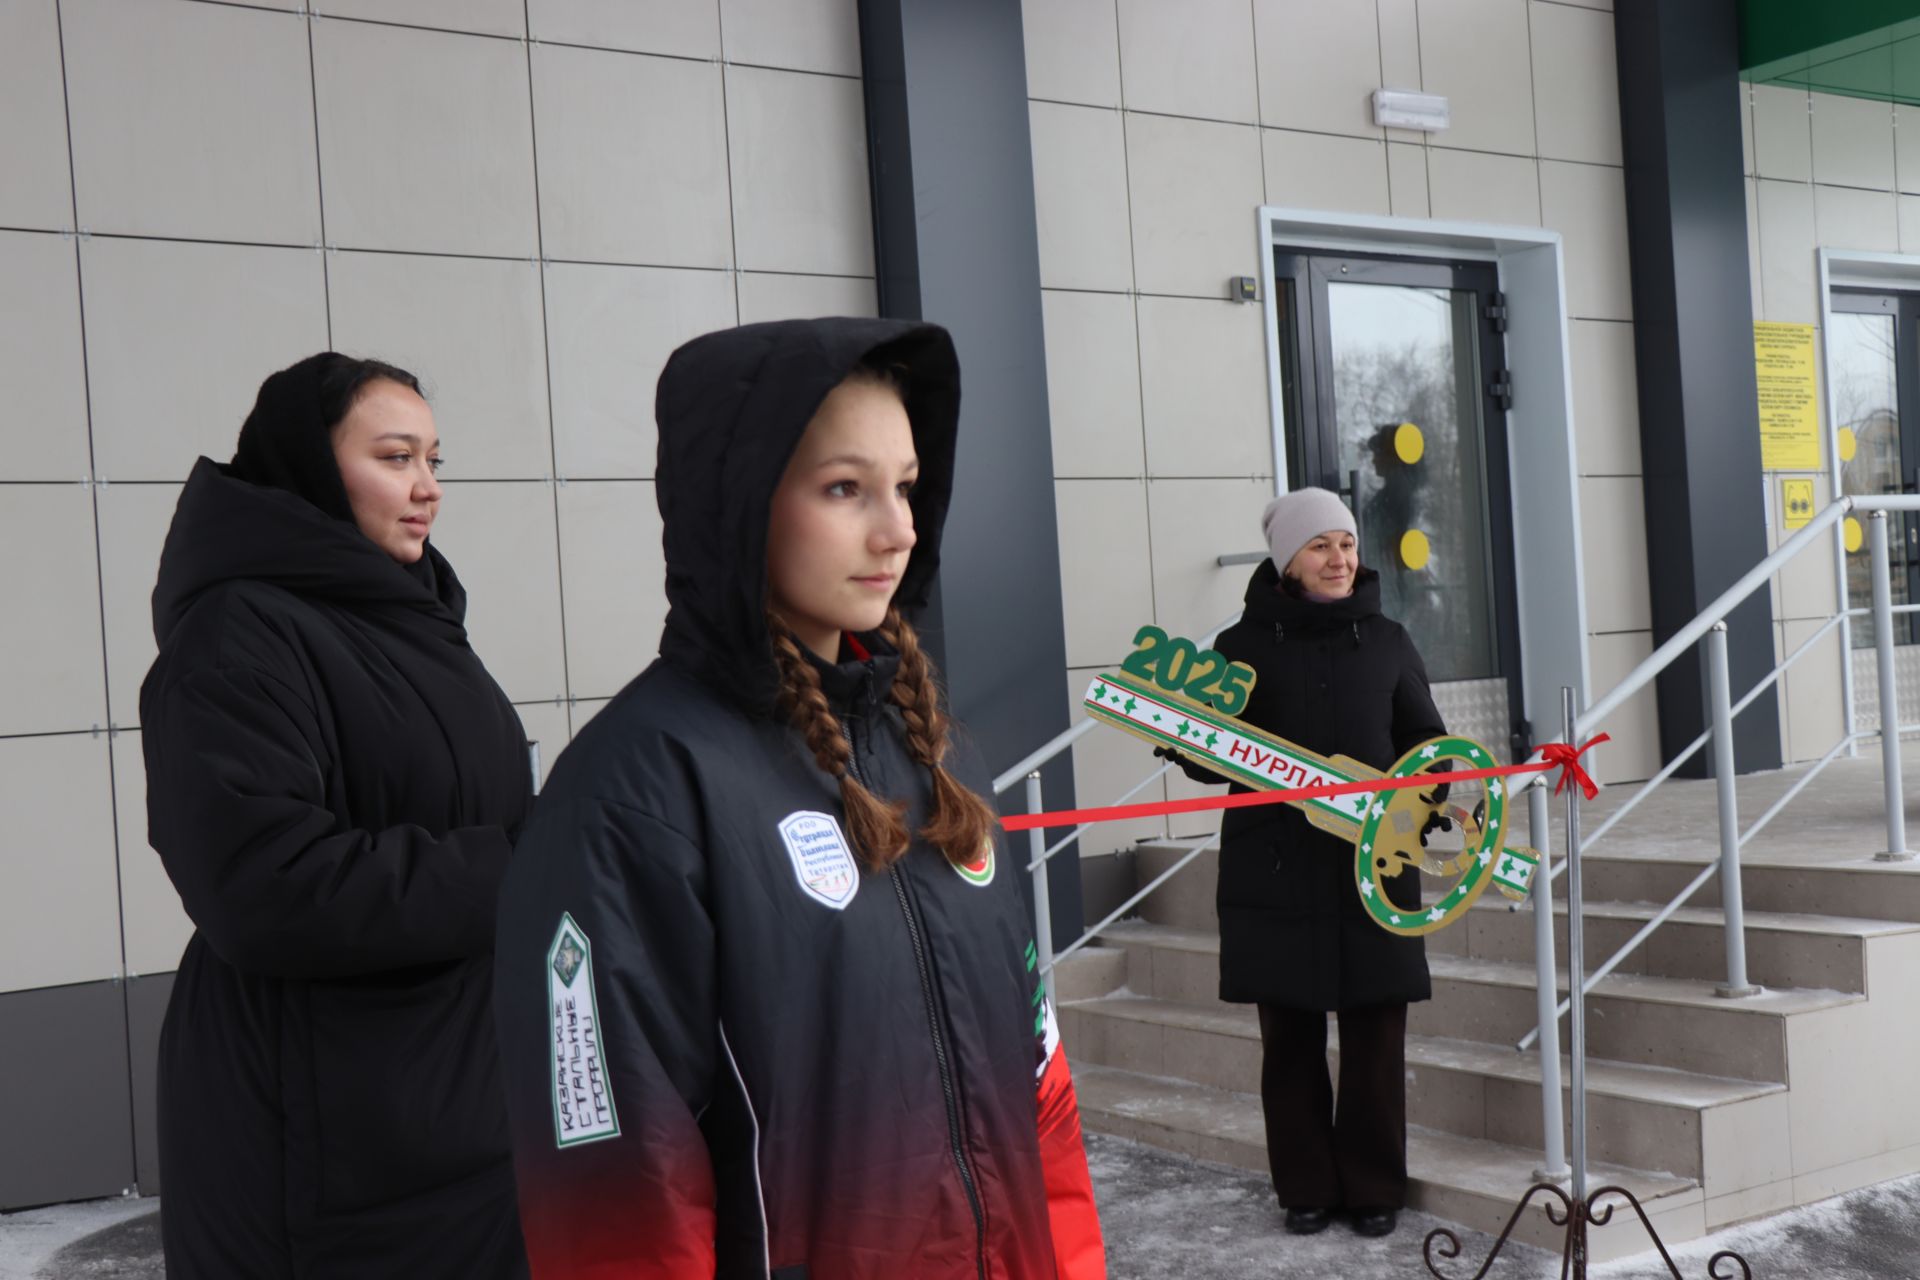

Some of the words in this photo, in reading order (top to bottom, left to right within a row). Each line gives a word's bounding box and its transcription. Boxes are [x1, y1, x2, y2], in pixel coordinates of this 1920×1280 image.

[1121, 625, 1254, 715] 2025
[555, 998, 574, 1131] КАЗАНСКИЕ
[565, 996, 592, 1128] СТАЛЬНЫЕ
[583, 1015, 609, 1124] ПРОФИЛИ
